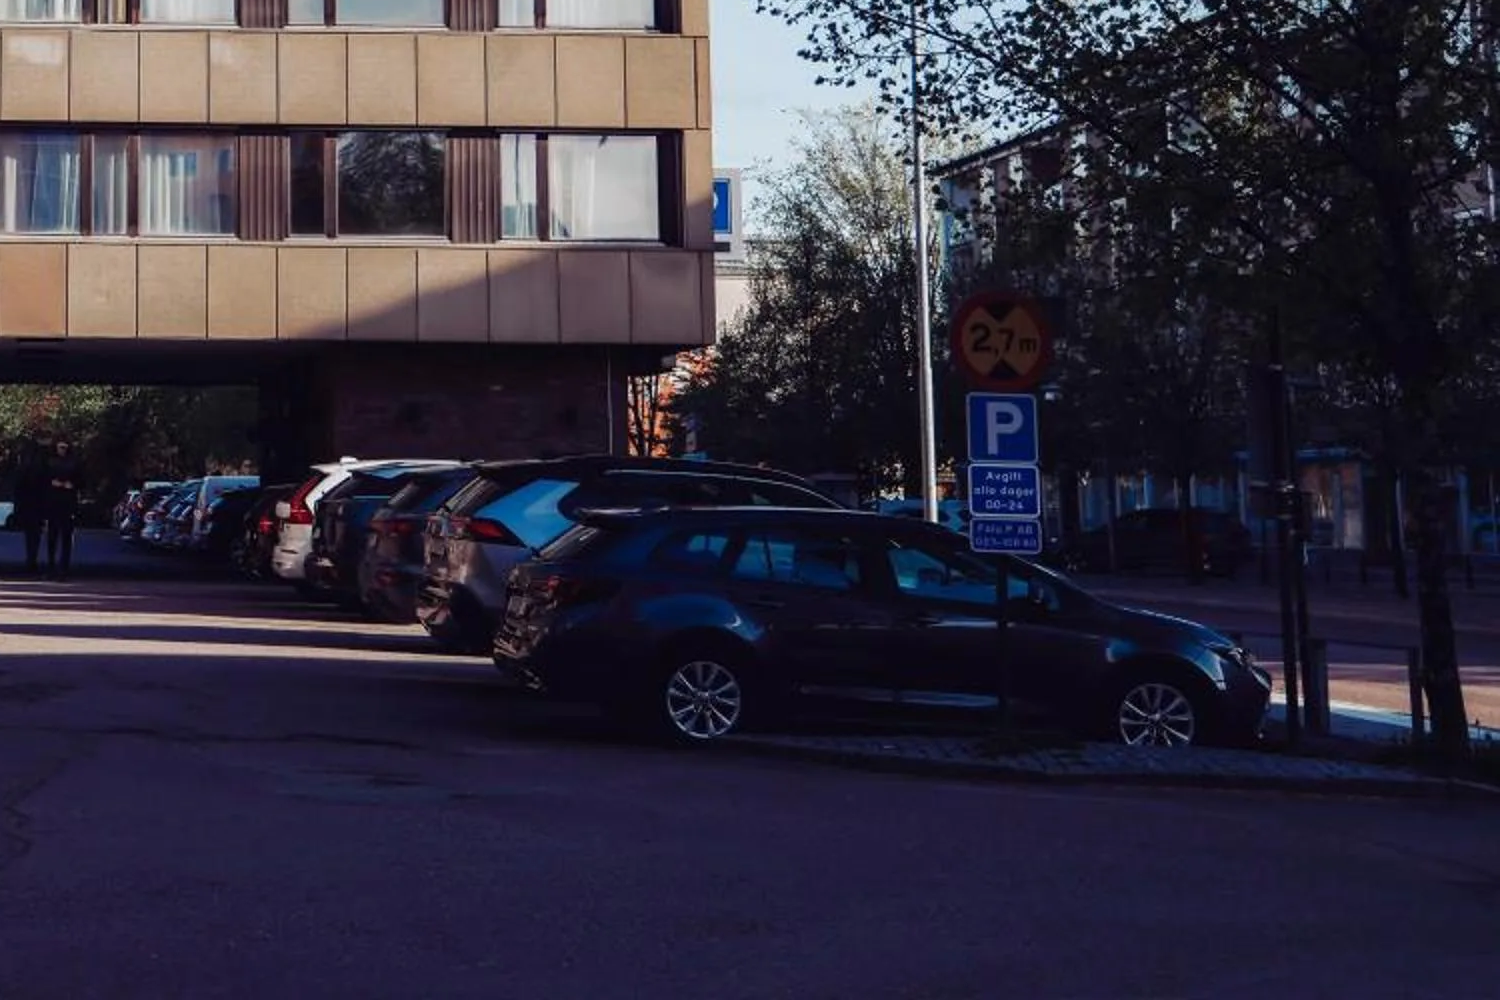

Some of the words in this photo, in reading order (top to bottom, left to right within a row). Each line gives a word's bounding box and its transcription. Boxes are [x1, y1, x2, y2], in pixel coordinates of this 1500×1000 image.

[969, 322, 1014, 357] 2,7
[1018, 337, 1037, 353] m
[985, 401, 1024, 455] P
[985, 471, 1022, 484] Avgift
